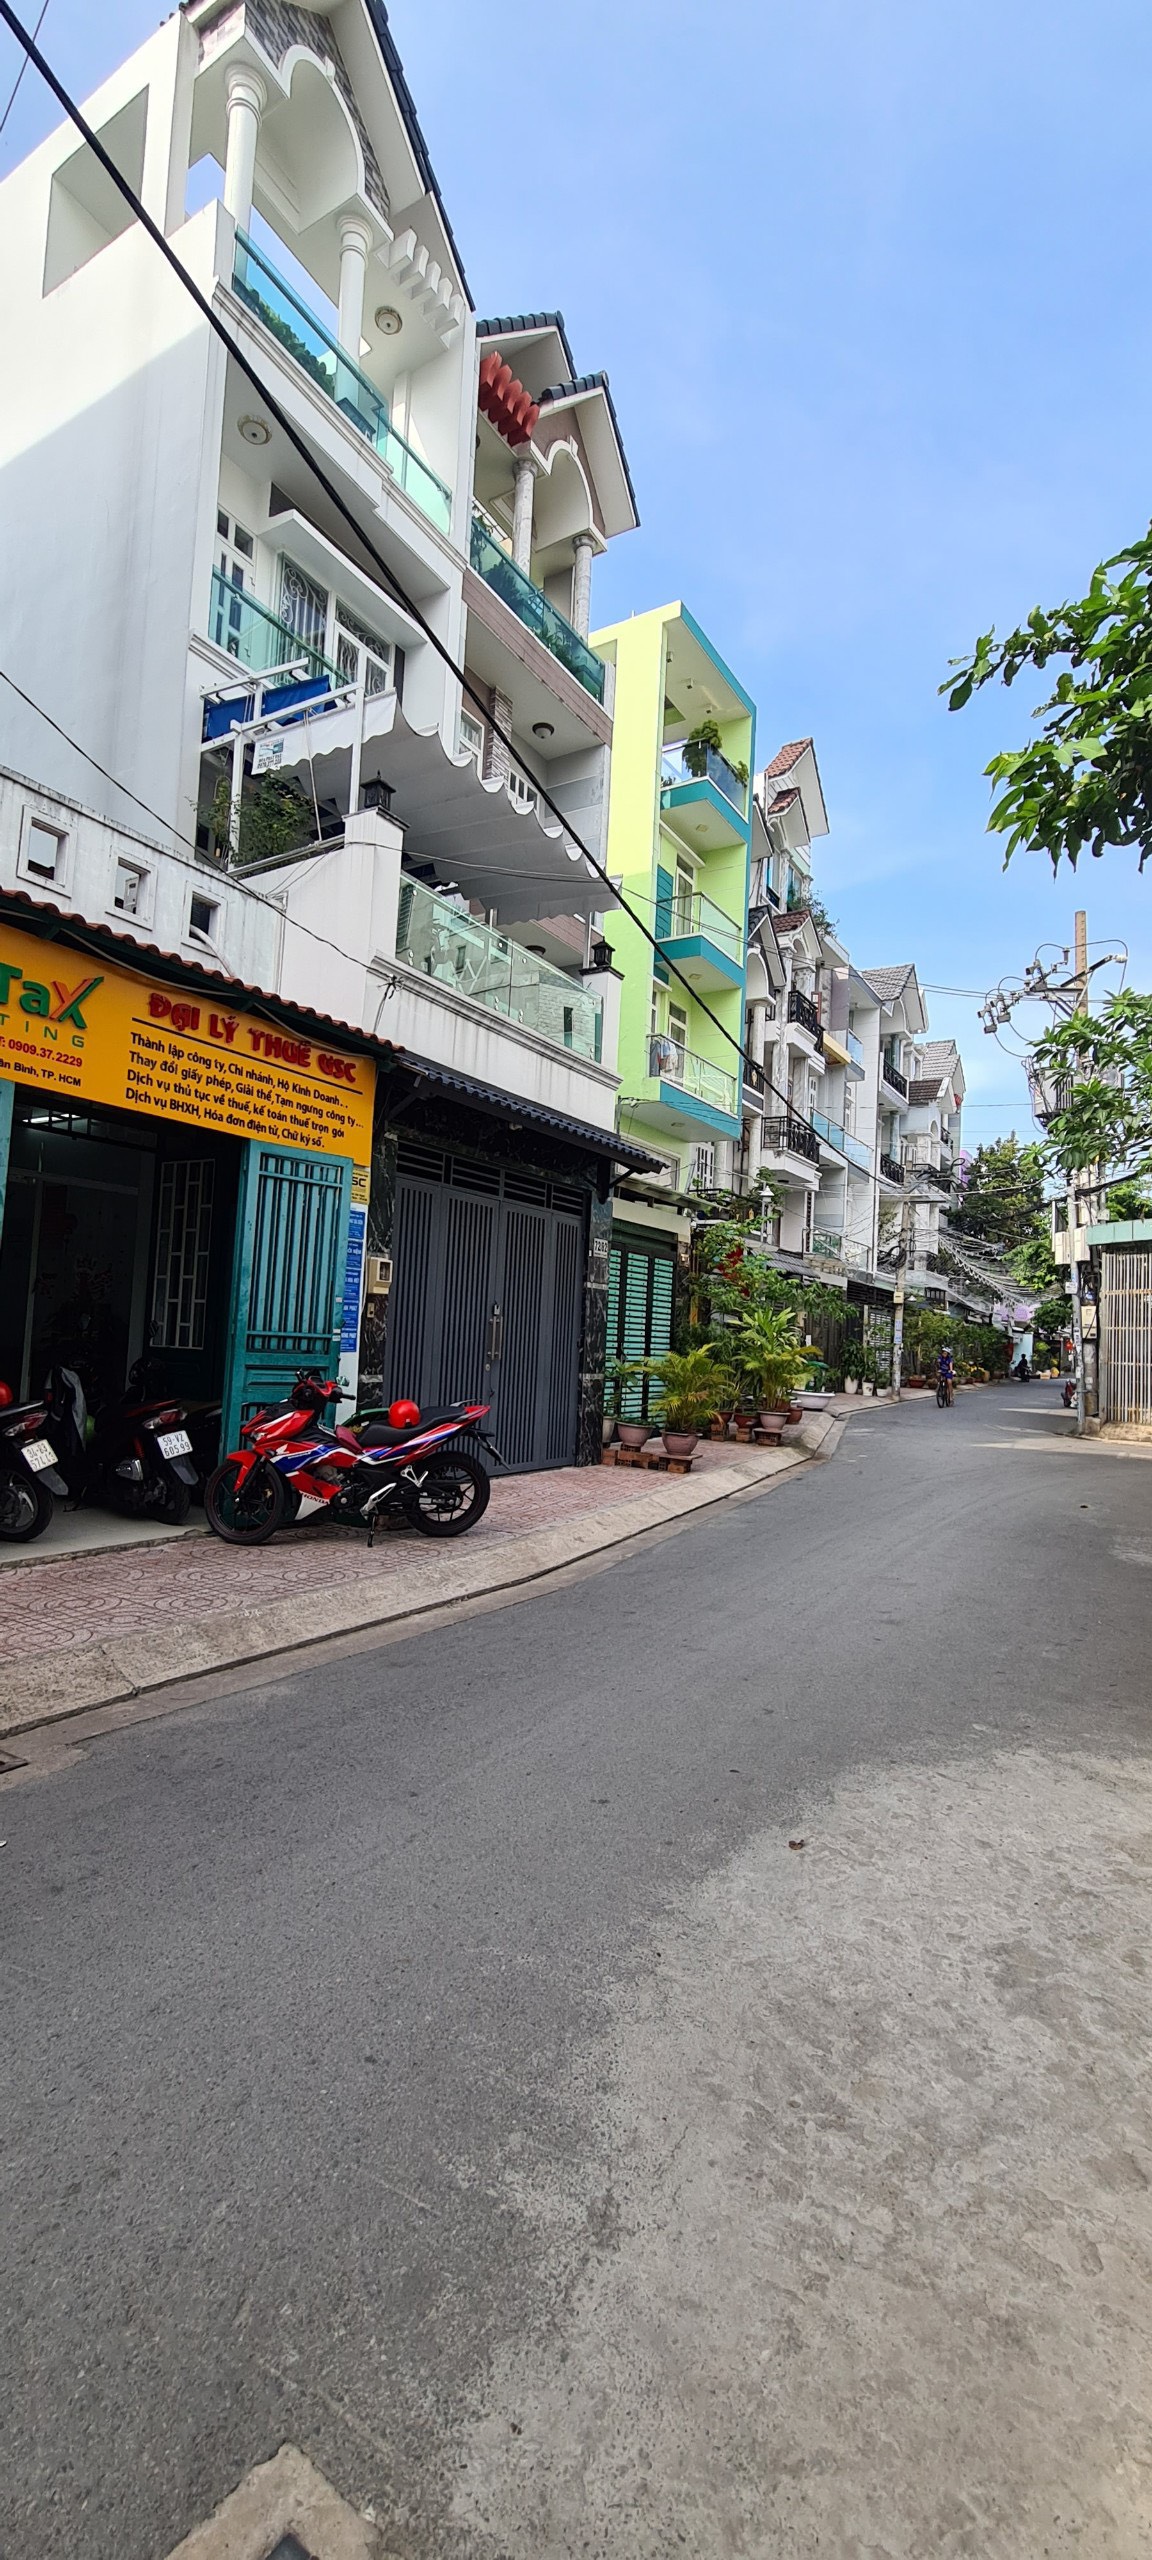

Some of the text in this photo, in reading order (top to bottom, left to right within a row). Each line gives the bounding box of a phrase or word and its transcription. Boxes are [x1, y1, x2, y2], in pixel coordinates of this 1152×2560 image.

[8, 1038, 83, 1067] 0909.37.2229
[148, 992, 200, 1031] ĐẠI
[209, 1014, 240, 1043] LÝ
[247, 1027, 312, 1068] THUẾ
[13, 1061, 39, 1078] Bình,
[41, 1068, 56, 1081] TP.
[58, 1073, 81, 1086] HCM
[129, 1050, 157, 1071] Thay
[160, 1060, 178, 1075] đổi
[181, 1068, 203, 1084] giấy
[205, 1074, 234, 1093] phép,
[235, 1082, 254, 1097] Giải
[256, 1089, 274, 1105] thể,
[275, 1093, 294, 1108] Tạm
[296, 1102, 323, 1118] ngưng
[326, 1110, 346, 1125] công
[131, 1032, 165, 1053] Thành
[168, 1043, 184, 1060] lập
[187, 1052, 212, 1069] công
[214, 1059, 227, 1074] ty,
[228, 1063, 244, 1077] Chi
[245, 1069, 276, 1089] nhánh,
[277, 1078, 290, 1092] Hộ
[292, 1082, 311, 1097] Kinh
[125, 1087, 325, 1148] Dịch vụ BHXH, Hóa đơn điện tử, Chữ ký số.
[127, 1069, 345, 1138] Dịch vụ thủ tục về thuế, kế toán thuế trọn gói
